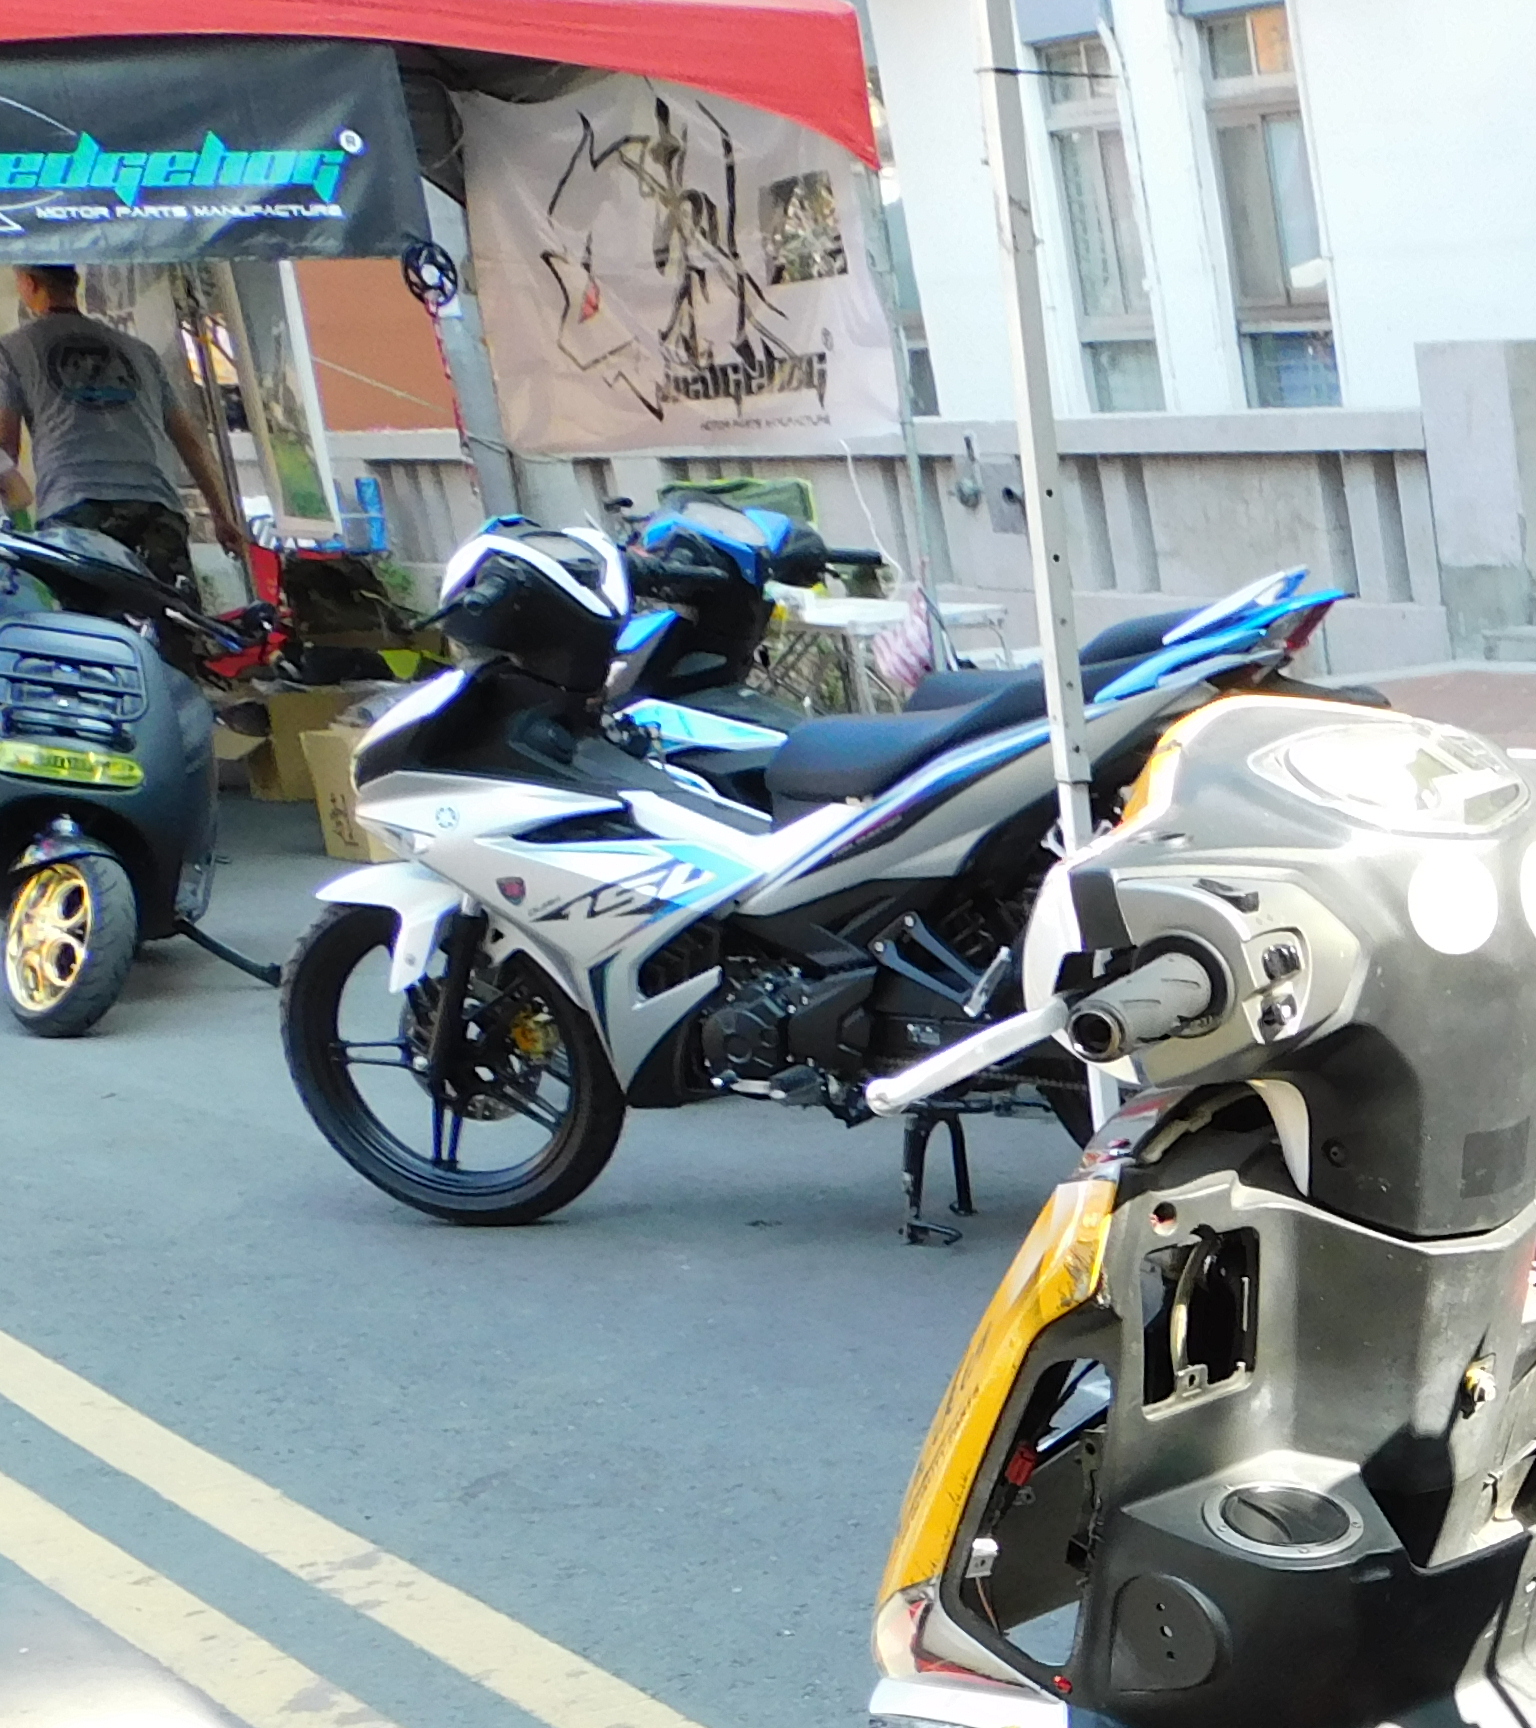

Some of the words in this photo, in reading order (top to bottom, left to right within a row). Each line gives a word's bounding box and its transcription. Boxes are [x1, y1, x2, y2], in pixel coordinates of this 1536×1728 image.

[36, 205, 109, 219] MOTOR
[116, 205, 187, 218] PARTS
[193, 204, 343, 217] MANUFACTURE
